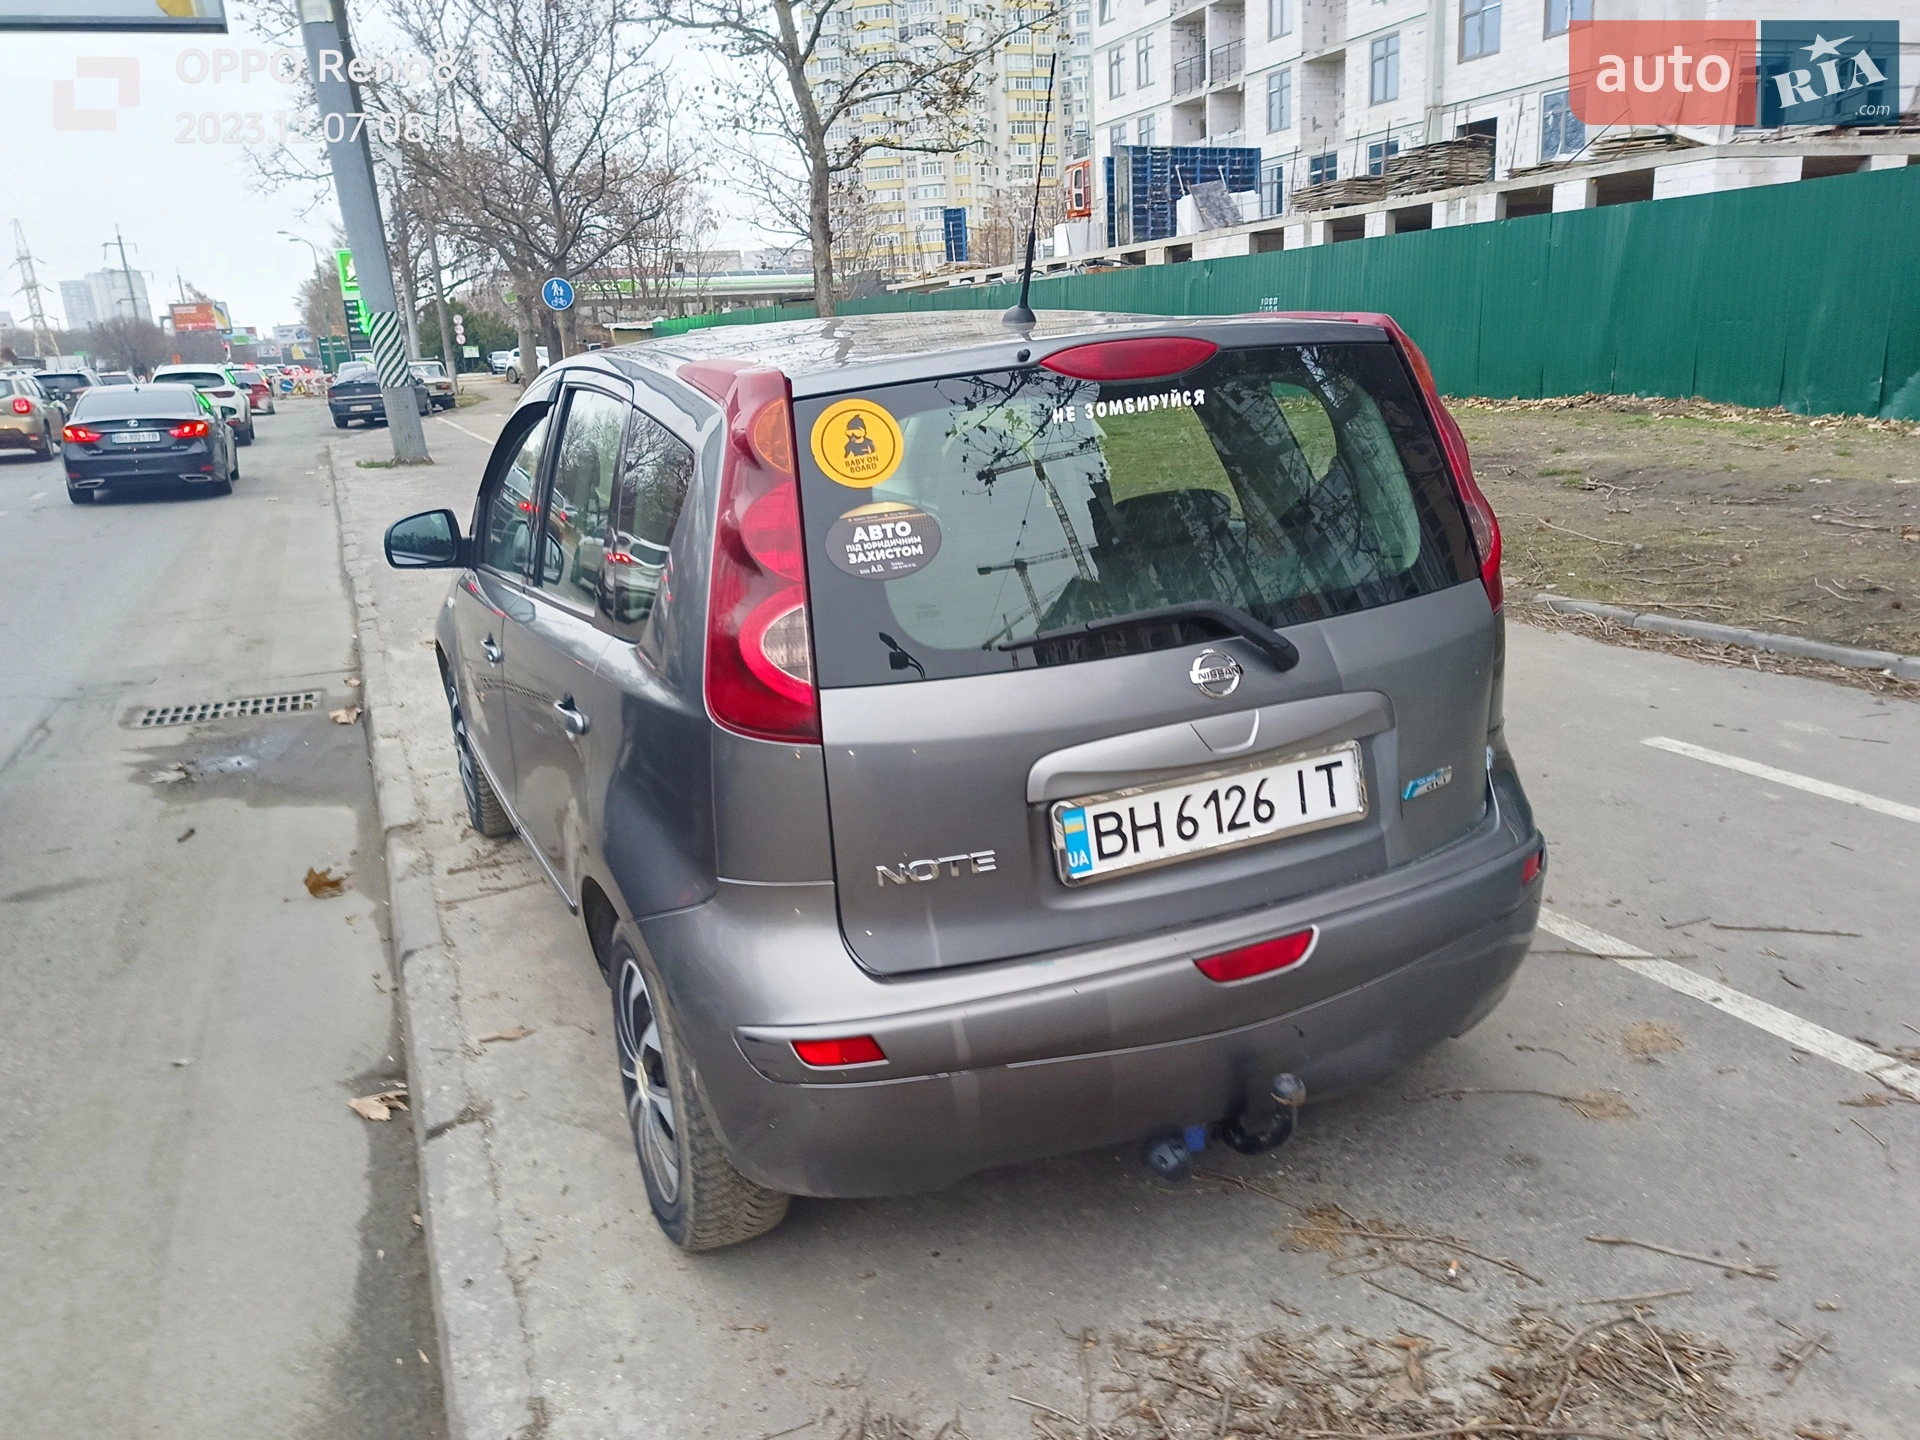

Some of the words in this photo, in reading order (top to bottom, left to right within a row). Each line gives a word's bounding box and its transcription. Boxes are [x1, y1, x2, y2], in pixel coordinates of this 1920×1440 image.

[1052, 405, 1076, 425] НЕ
[1084, 388, 1206, 420] ЗОМБИРУЙСЯ
[844, 457, 865, 468] BABY
[866, 455, 879, 463] ON
[850, 462, 877, 473] BOARD
[853, 521, 912, 543] АВТО
[845, 543, 862, 553] ПІД
[863, 535, 922, 551] ЮРИДИЧНИМ
[847, 543, 924, 565] ЗАХИСТОМ
[1197, 664, 1241, 681] NISSAN
[1093, 801, 1165, 862] BH
[1176, 777, 1276, 842] 6126
[1297, 760, 1344, 816] IT
[875, 849, 997, 888] NOTE
[1068, 848, 1090, 869] UA
